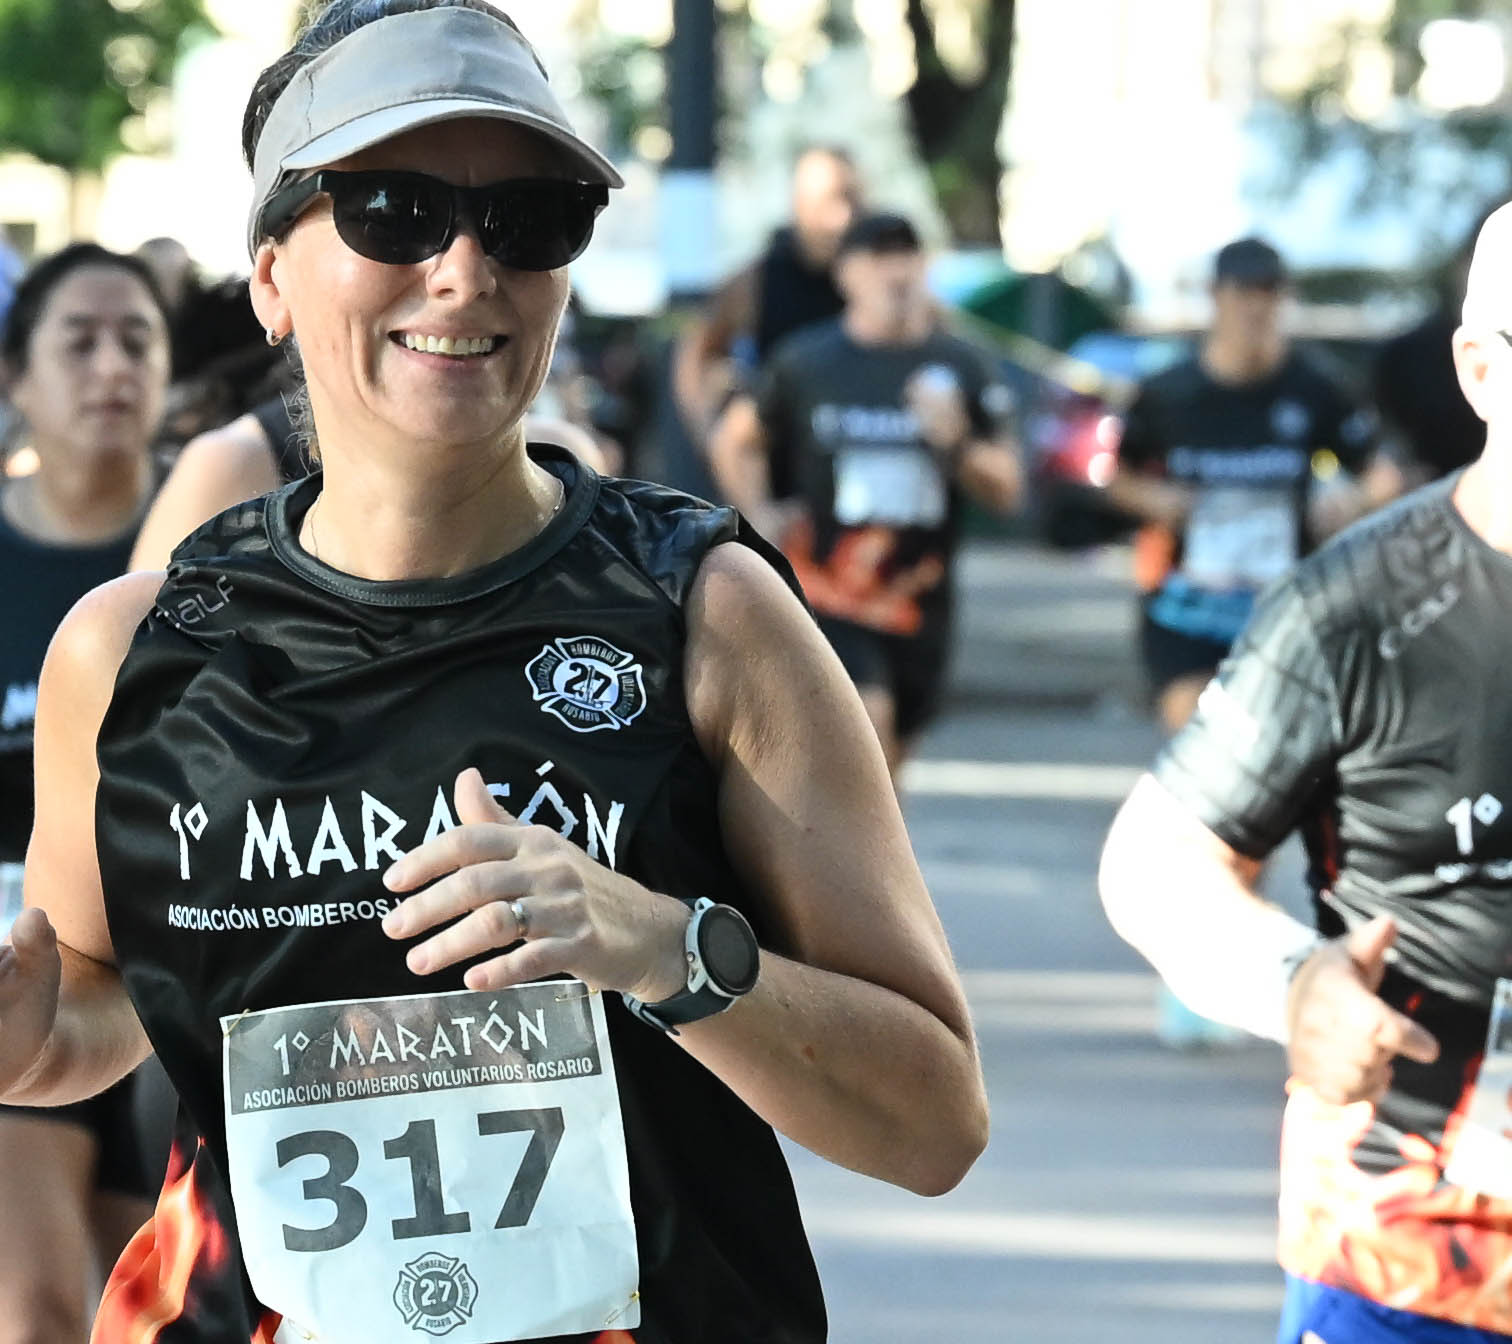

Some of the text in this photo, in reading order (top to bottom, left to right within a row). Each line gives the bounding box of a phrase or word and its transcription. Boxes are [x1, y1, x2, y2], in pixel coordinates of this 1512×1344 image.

[563, 661, 613, 700] 27
[239, 759, 625, 881] MARAÓN
[168, 897, 391, 931] ASOCIACIÓN BOMBEROS
[329, 1000, 549, 1071] MARATÓN
[243, 1056, 594, 1110] ASOCIACIÓN BOMBEROS VOLUNTARIOS ROSARIO
[275, 1106, 566, 1253] 317
[419, 1277, 452, 1307] 27
